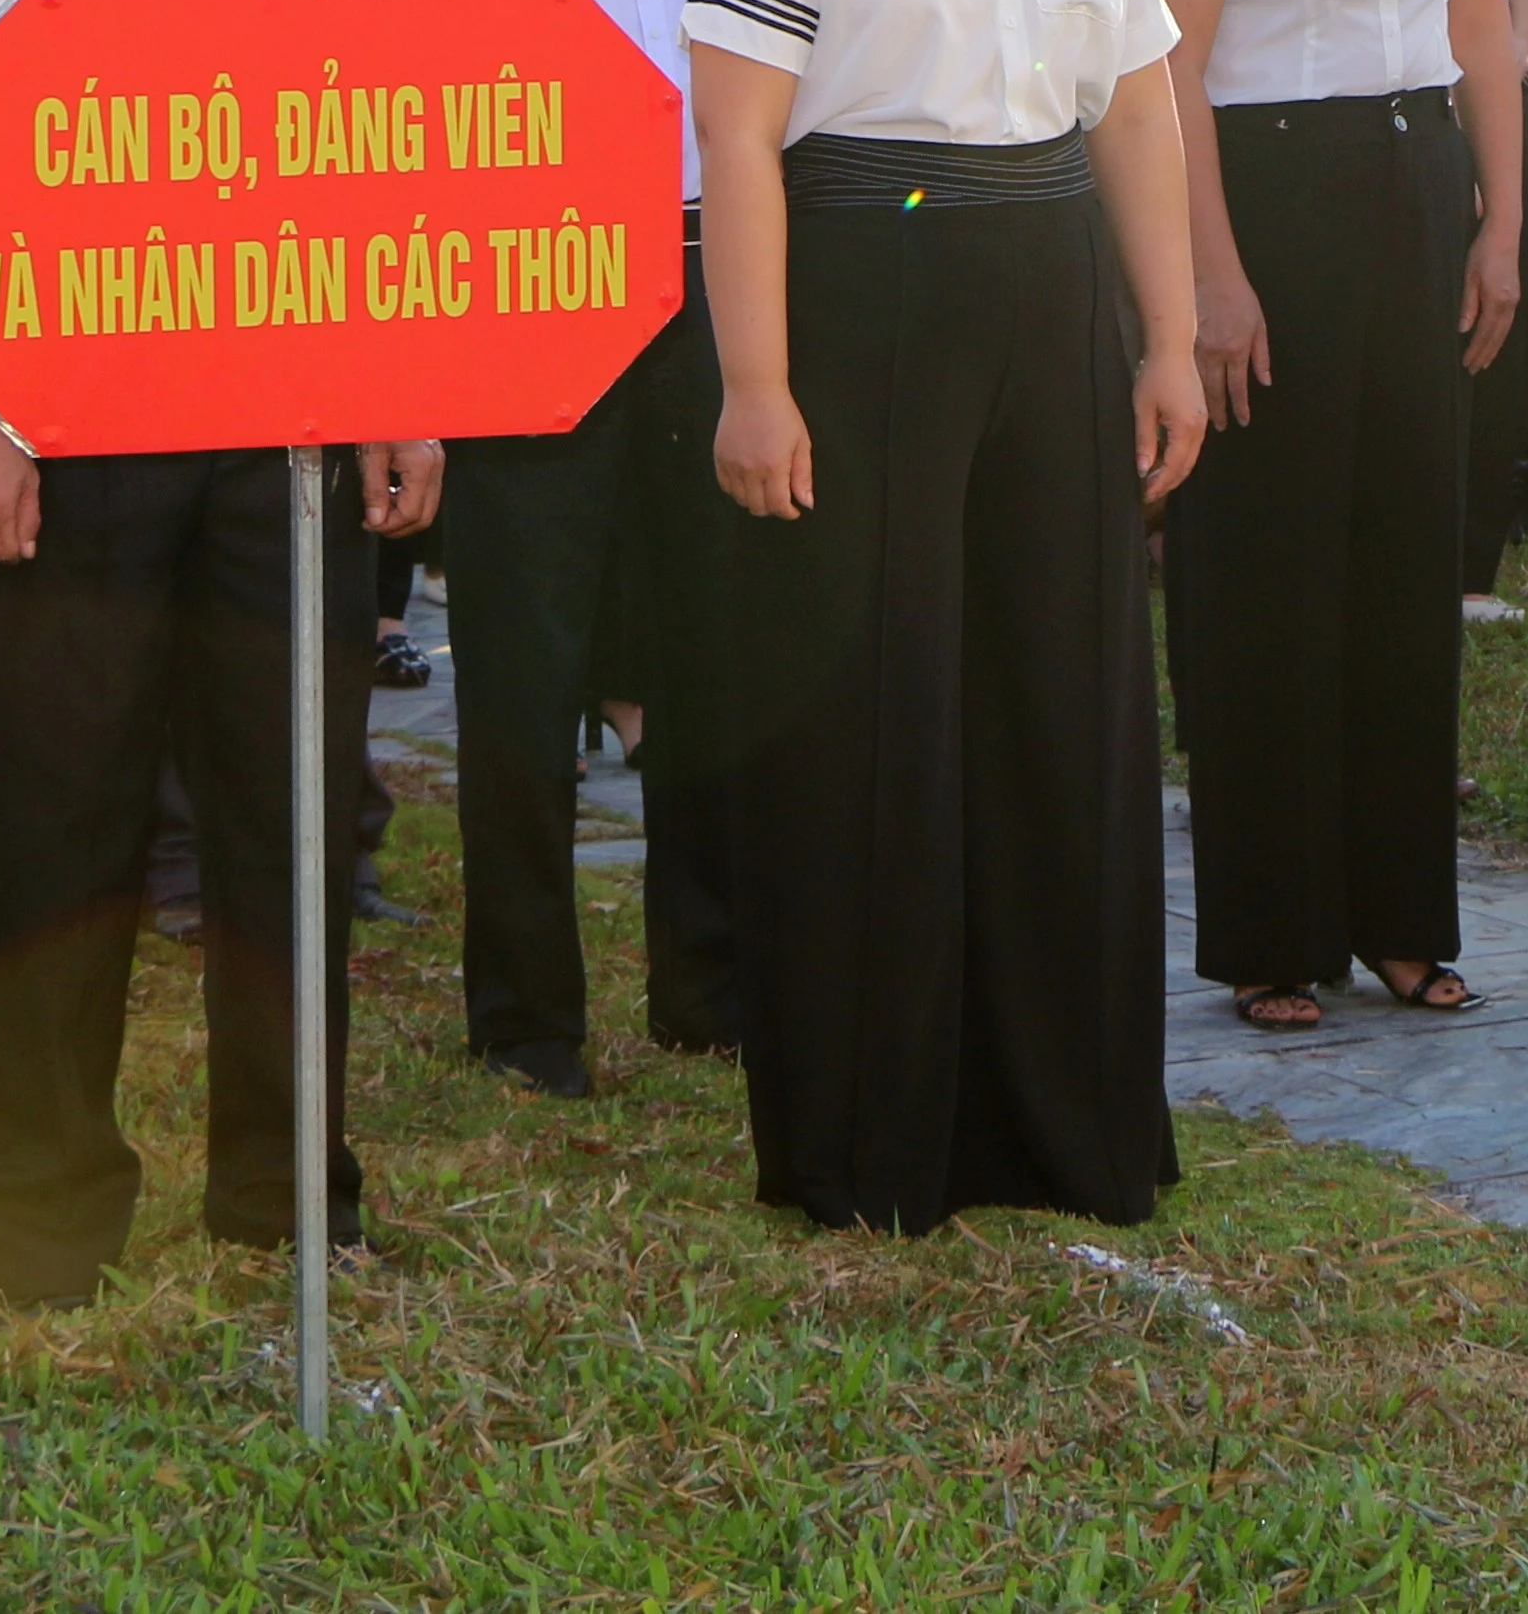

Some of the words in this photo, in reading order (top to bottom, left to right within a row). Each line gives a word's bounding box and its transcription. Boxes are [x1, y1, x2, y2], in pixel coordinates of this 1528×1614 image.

[33, 76, 151, 189] CÁN
[167, 71, 259, 201] BỘ,
[273, 56, 426, 178] ĐẢNG
[440, 62, 564, 174] VIÊN
[58, 224, 217, 338] NHÂN
[233, 218, 348, 329] DÂN
[364, 212, 473, 323] CÁC
[487, 205, 627, 315] THÔN
